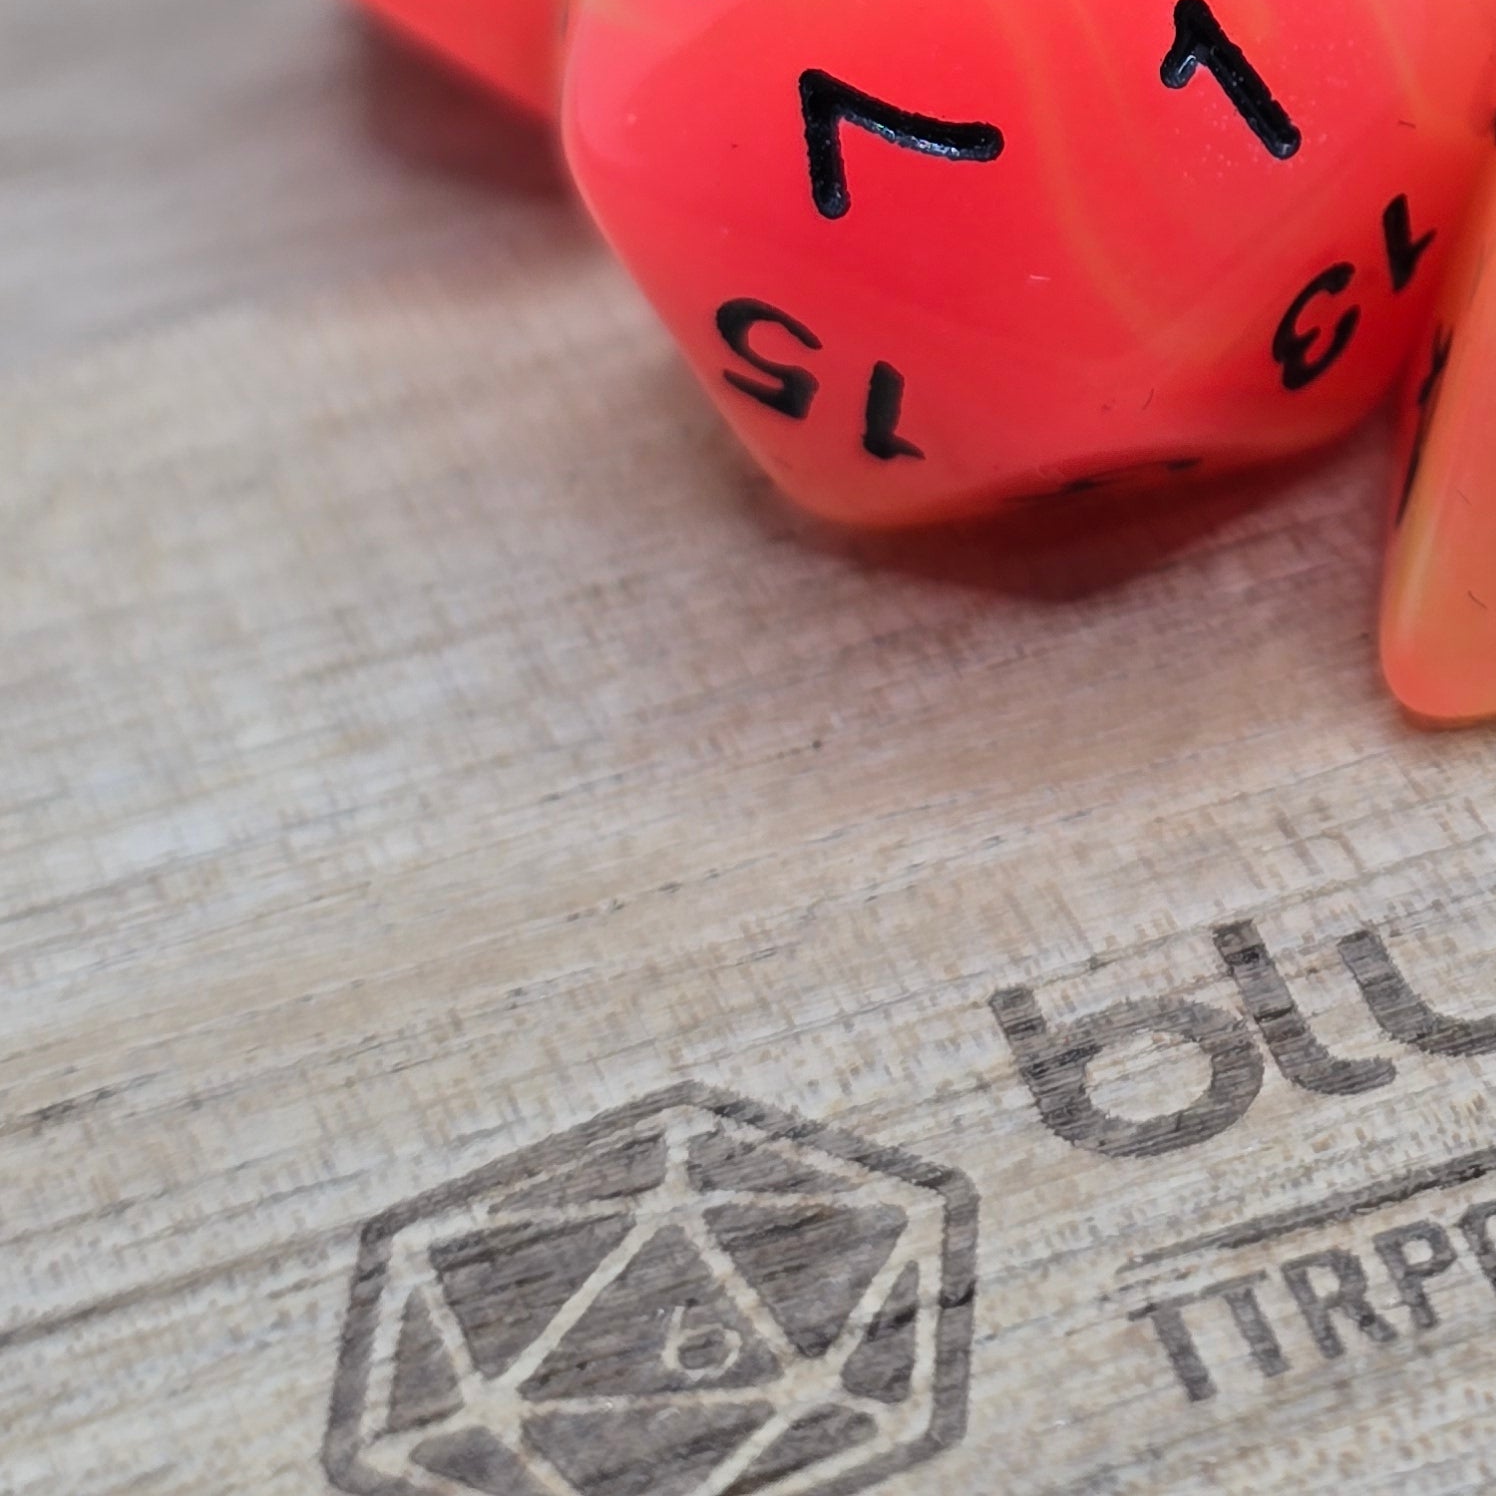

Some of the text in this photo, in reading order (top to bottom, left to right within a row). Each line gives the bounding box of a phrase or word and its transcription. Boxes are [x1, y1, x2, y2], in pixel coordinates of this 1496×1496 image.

[798, 68, 1005, 219] 7
[1271, 193, 1436, 390] 13
[715, 296, 925, 461] 15
